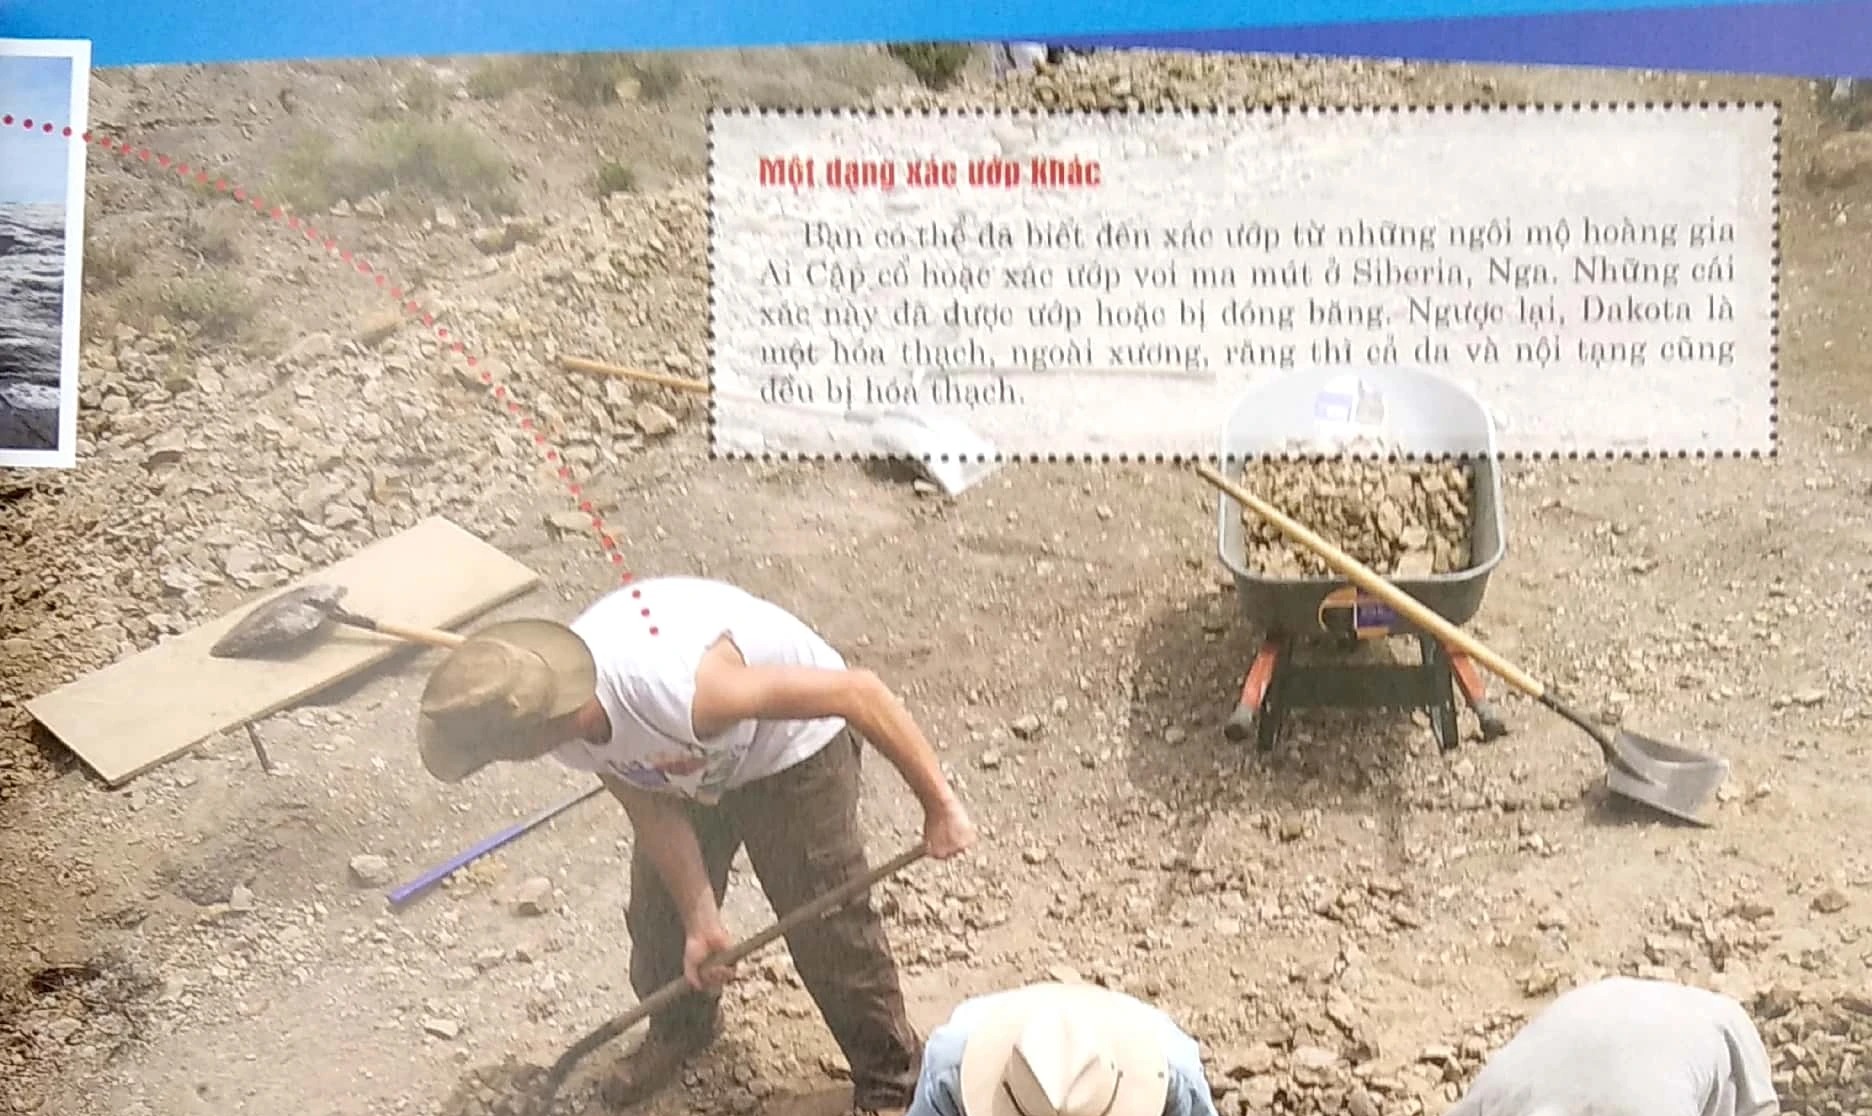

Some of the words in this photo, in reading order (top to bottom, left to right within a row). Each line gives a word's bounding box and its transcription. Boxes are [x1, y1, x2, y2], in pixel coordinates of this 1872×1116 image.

[759, 155, 815, 195] Một
[825, 157, 895, 194] dạng
[906, 154, 957, 188] xác
[968, 156, 1021, 188] ướp
[804, 221, 862, 253] Bạn
[875, 221, 906, 249] có
[917, 210, 966, 253] thể
[1026, 216, 1084, 249] biết
[1097, 215, 1149, 249] đến
[1163, 219, 1213, 249] xác
[1225, 221, 1280, 253] ướp
[1293, 221, 1324, 245] từ
[1337, 218, 1437, 251] những
[1449, 216, 1513, 251] ngôi
[1526, 220, 1570, 251] mộ
[1583, 216, 1677, 248] hoàng
[1689, 215, 1735, 246] gia
[760, 263, 792, 287] Ai
[806, 261, 865, 294] Cập
[878, 258, 908, 288] cổ
[922, 262, 991, 291] hoặc
[1004, 262, 1053, 287] xác
[1067, 262, 1120, 292] ướp
[1135, 260, 1176, 287] voi
[1192, 266, 1235, 288] ma
[1251, 260, 1311, 288] mút
[1324, 257, 1340, 285] ở
[1353, 256, 1473, 289] Siberia,
[1488, 257, 1557, 288] Nga.
[1573, 255, 1678, 287] Những
[1692, 254, 1735, 283] cái
[760, 299, 811, 327] xác
[824, 299, 876, 329] này
[893, 299, 928, 327] đã
[944, 299, 1013, 330] được
[1027, 300, 1081, 330] ướp
[1097, 298, 1166, 330] hoặc
[1180, 298, 1205, 330] bị
[1221, 298, 1294, 328] đóng
[1309, 297, 1390, 328] băng.
[1408, 297, 1503, 329] Ngược
[1520, 296, 1565, 327] lại,
[1583, 296, 1691, 321] Dakota
[1707, 295, 1735, 320] là
[760, 340, 816, 368] một
[902, 338, 995, 369] thạch,
[1011, 337, 1093, 371] ngoài
[1108, 342, 1210, 371] xương,
[1224, 339, 1295, 367] răng
[1311, 336, 1351, 364] thì
[1366, 333, 1397, 362] cả
[1415, 338, 1449, 362] da
[1466, 337, 1499, 362] và
[1515, 334, 1560, 367] nội
[1578, 338, 1647, 367] tạng
[1660, 336, 1735, 365] cũng
[760, 374, 814, 404] đều
[827, 376, 853, 408] bị
[931, 376, 1025, 409] thạch.
